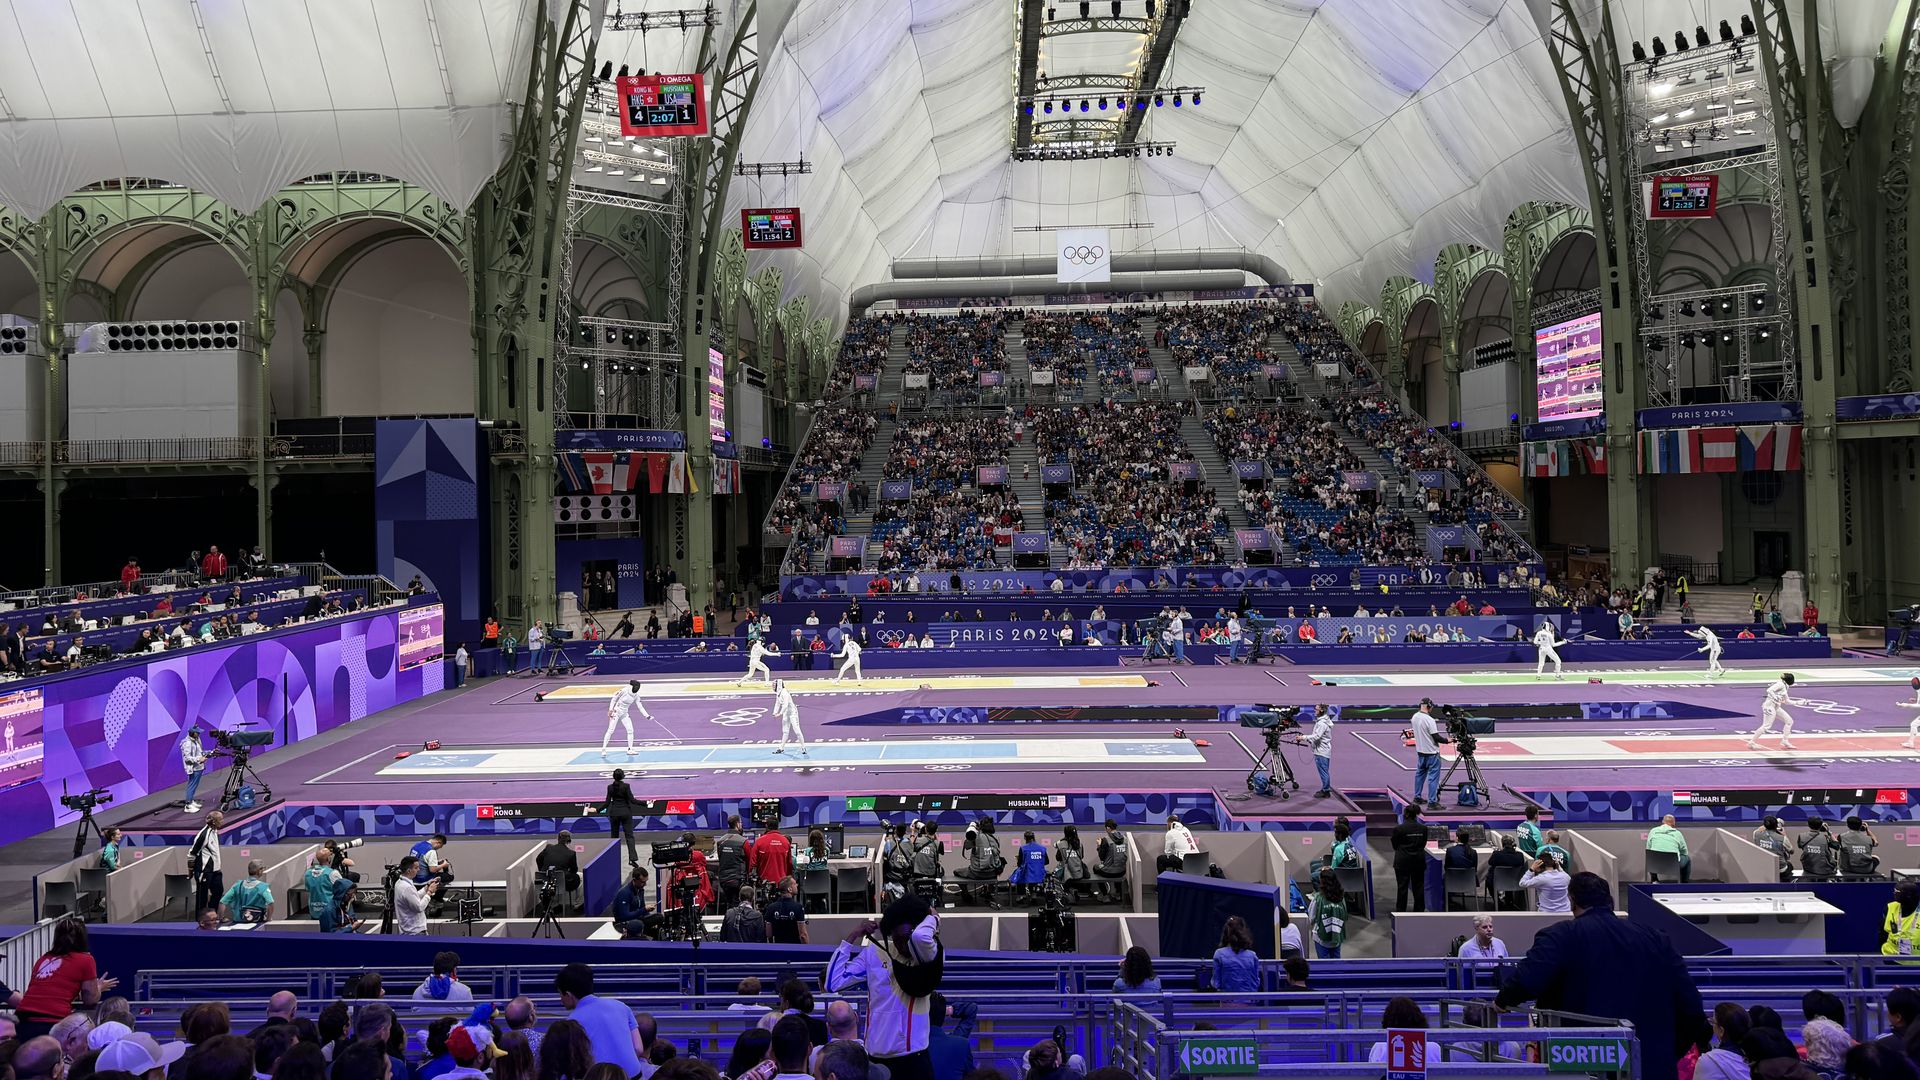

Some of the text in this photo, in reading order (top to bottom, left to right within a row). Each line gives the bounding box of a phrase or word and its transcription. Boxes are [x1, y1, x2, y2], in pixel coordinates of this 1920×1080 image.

[631, 94, 644, 106] HKG
[664, 93, 677, 105] USA
[634, 110, 644, 121] 4
[651, 113, 674, 123] 2:07
[682, 109, 690, 120] 1
[1663, 200, 1670, 208] 4
[753, 231, 759, 240] 2
[785, 230, 791, 239] 2
[1671, 409, 1734, 420] PARIS 2024
[617, 563, 639, 571] PARIS
[617, 570, 639, 579] 2024
[930, 580, 976, 590] PAIS
[950, 628, 1060, 641] PARIS 2024
[1899, 791, 1906, 800] 3
[688, 803, 695, 811] 4
[847, 799, 852, 808] 1
[1040, 799, 1048, 807] H.
[1182, 832, 1196, 851] USA
[1191, 1046, 1256, 1066] SORTIE
[1551, 1045, 1617, 1064] SORTIE
